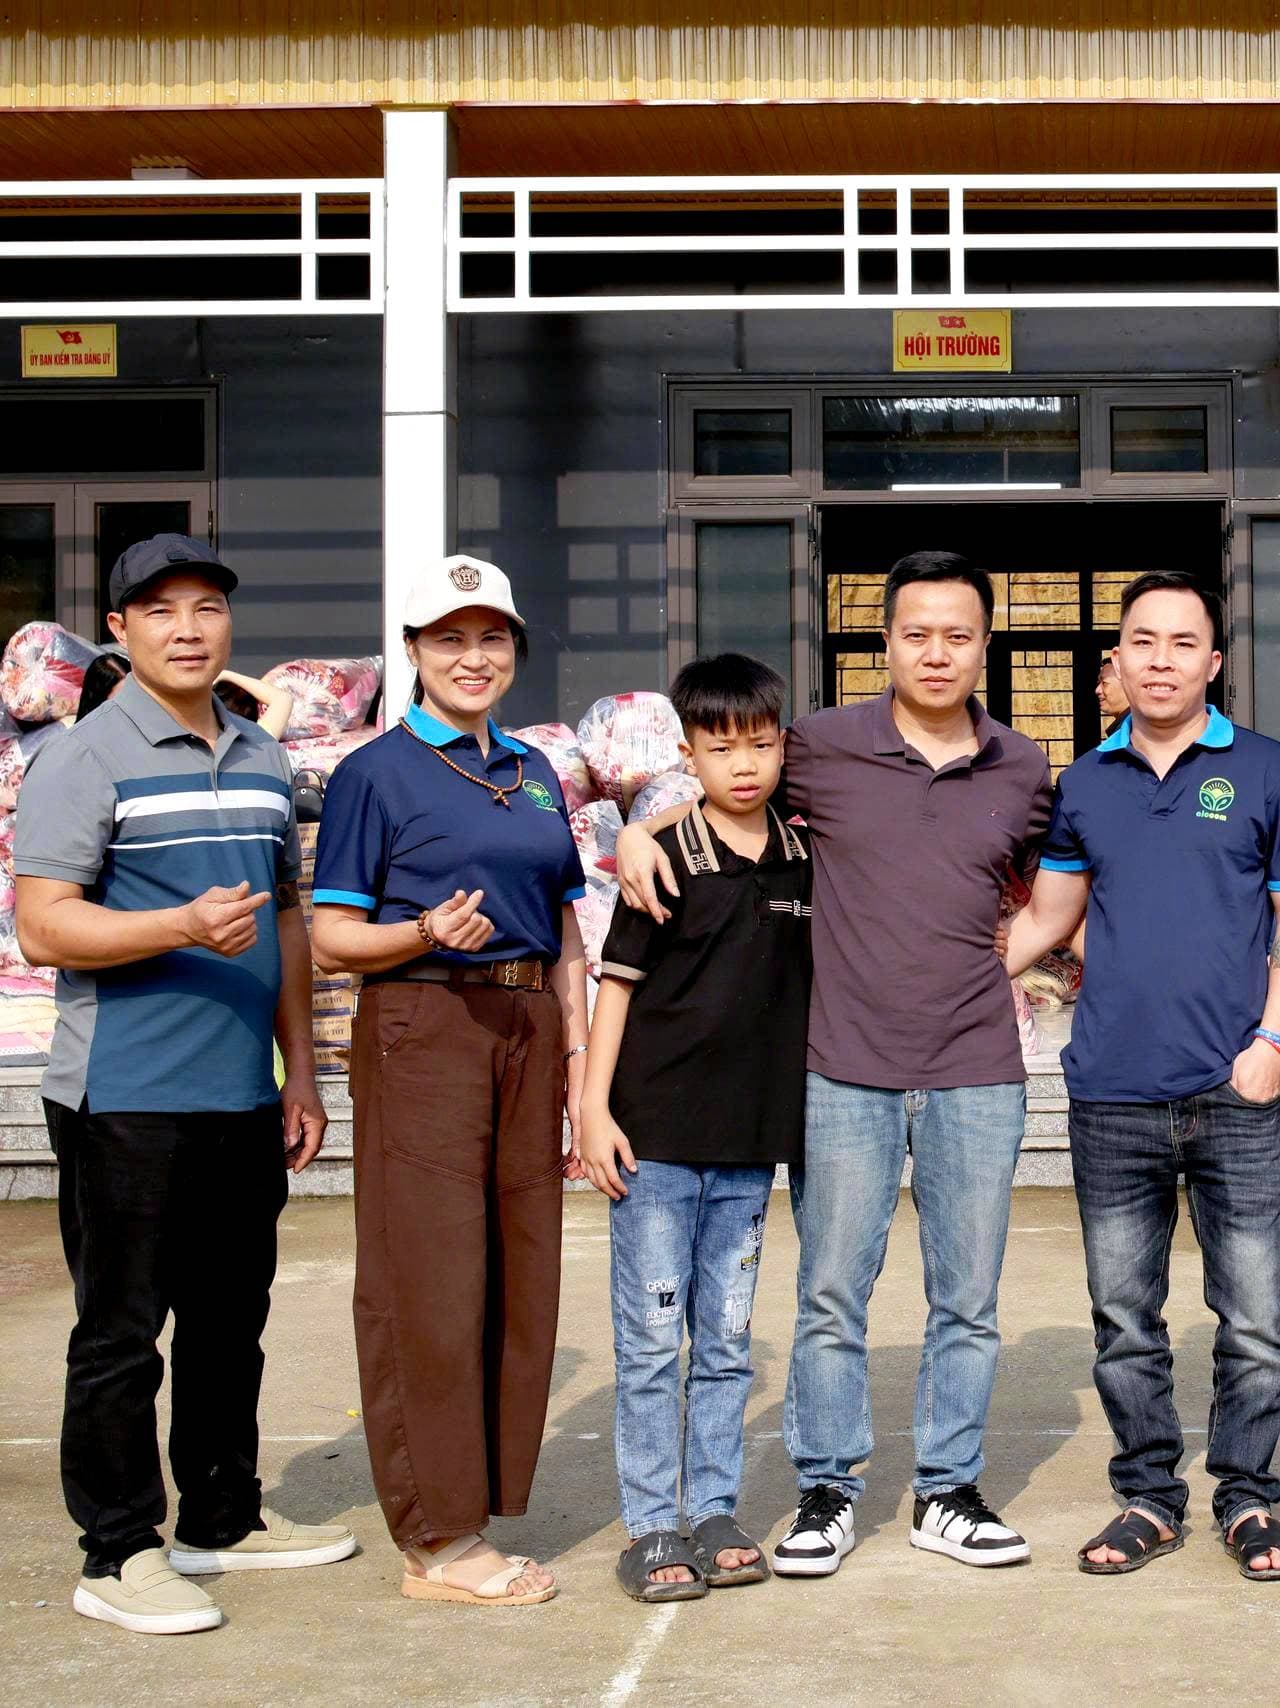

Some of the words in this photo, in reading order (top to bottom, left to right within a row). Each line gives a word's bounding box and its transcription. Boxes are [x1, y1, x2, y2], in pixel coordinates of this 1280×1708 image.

[904, 331, 931, 360] HỘI
[936, 331, 1000, 356] TRƯỜNG
[40, 353, 52, 366] BAN
[71, 353, 82, 365] TRA
